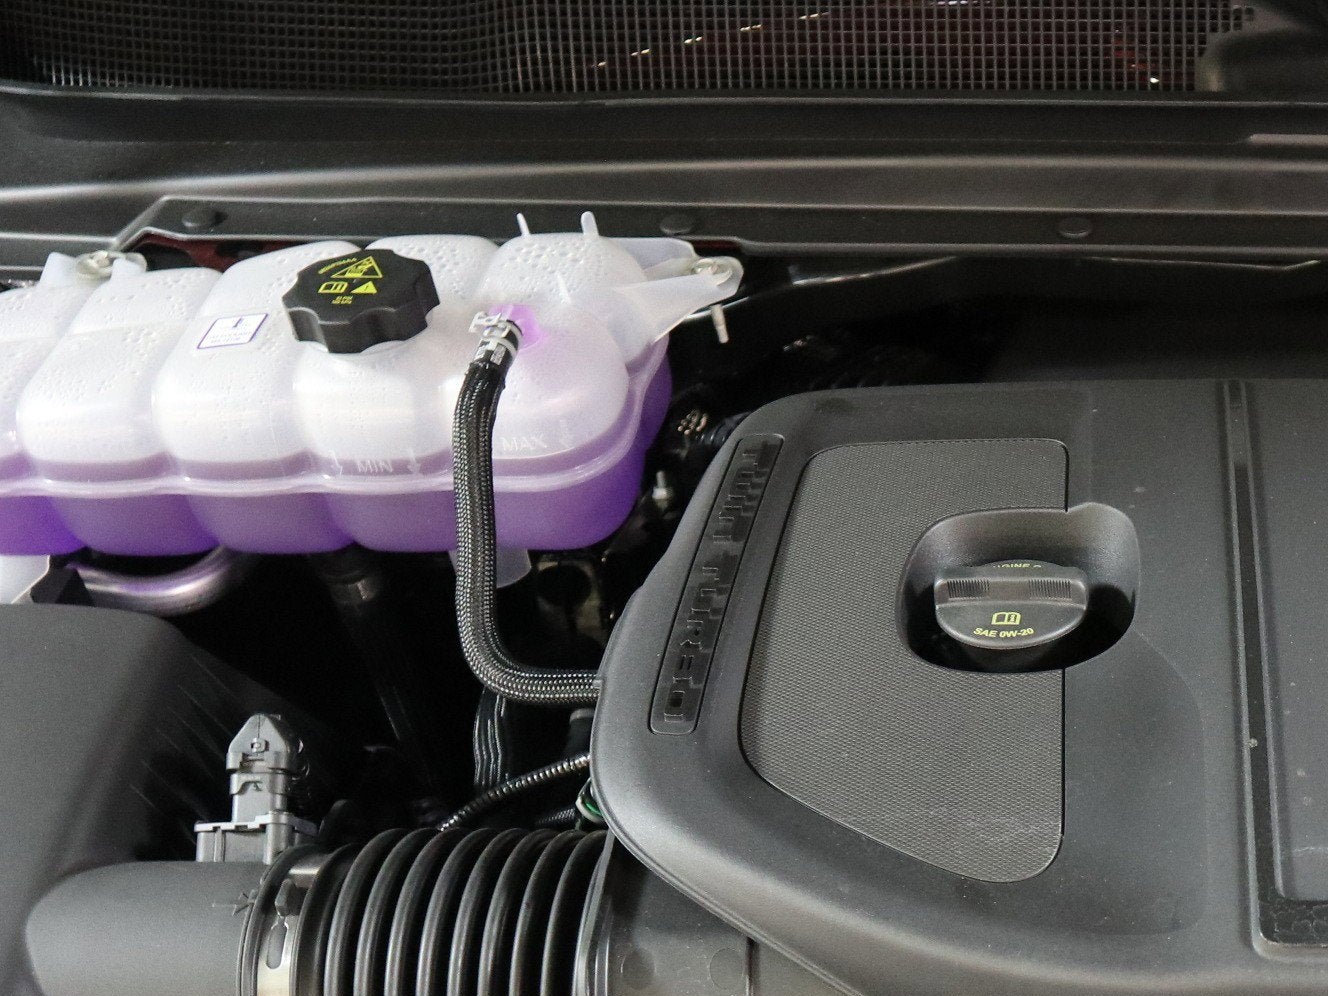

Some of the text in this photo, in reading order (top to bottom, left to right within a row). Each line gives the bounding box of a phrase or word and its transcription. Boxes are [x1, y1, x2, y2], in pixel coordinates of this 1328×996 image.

[501, 433, 547, 451] MAX
[356, 458, 393, 473] MIN
[973, 627, 1035, 638] SAE 0W-20
